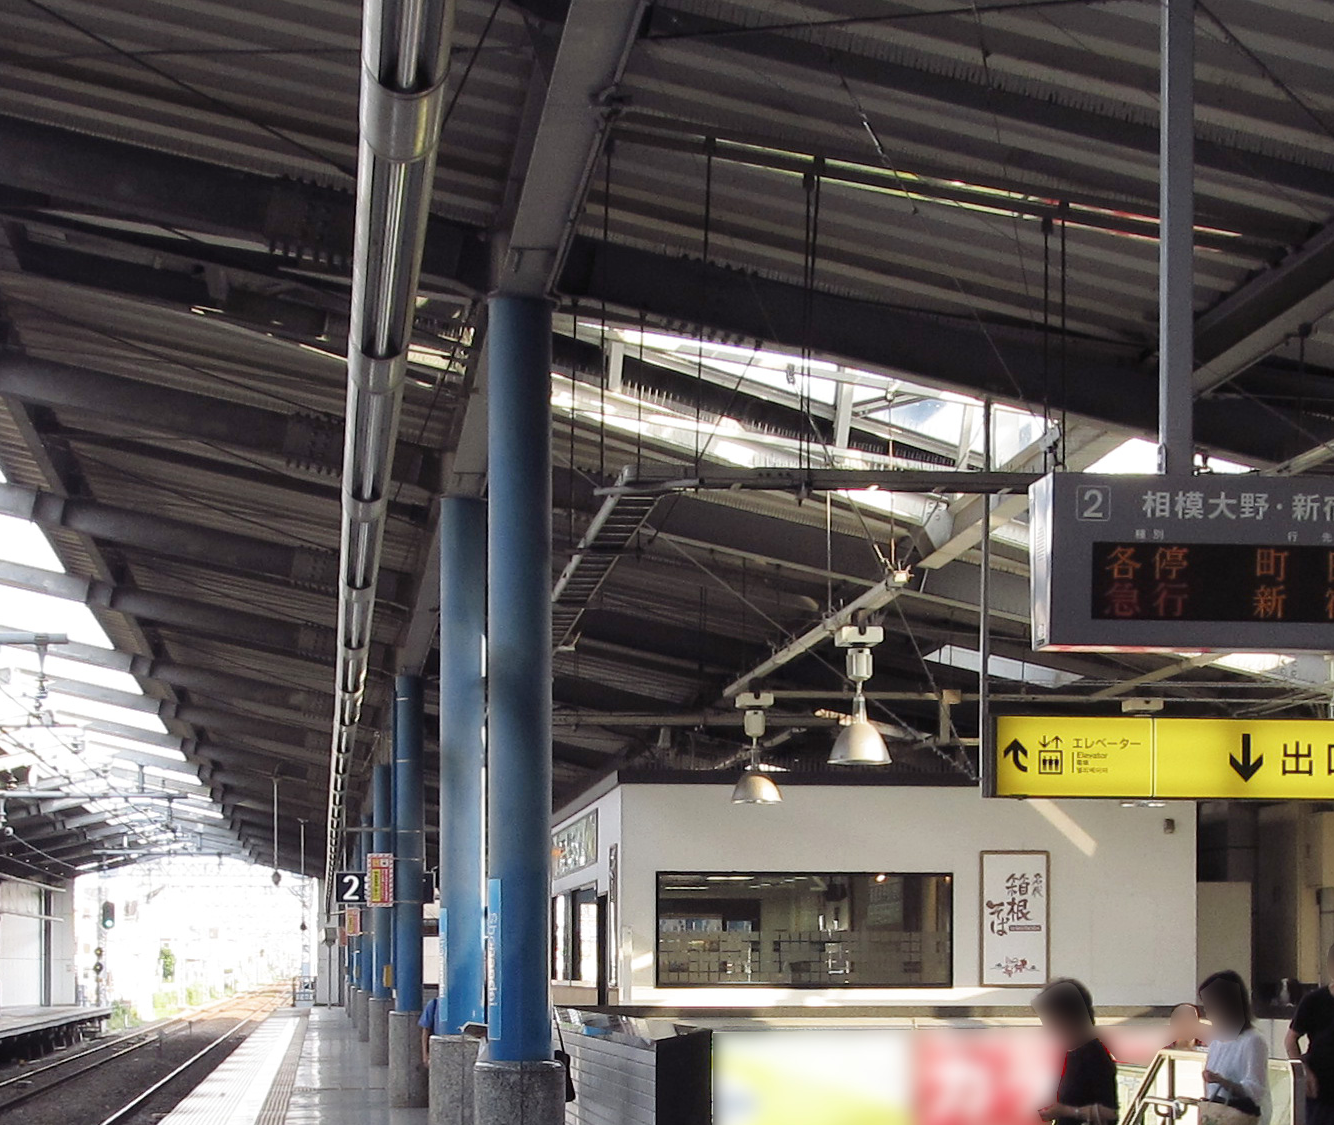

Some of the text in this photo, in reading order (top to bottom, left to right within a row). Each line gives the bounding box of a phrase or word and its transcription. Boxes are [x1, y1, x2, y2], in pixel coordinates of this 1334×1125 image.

[1082, 488, 1104, 519] 2
[1104, 546, 1189, 581] 各停
[1103, 581, 1189, 618] 急行
[1072, 738, 1142, 750] エレベーター
[1076, 751, 1108, 759] Elevator
[342, 874, 360, 901] 2
[1005, 872, 1034, 922] 箱根
